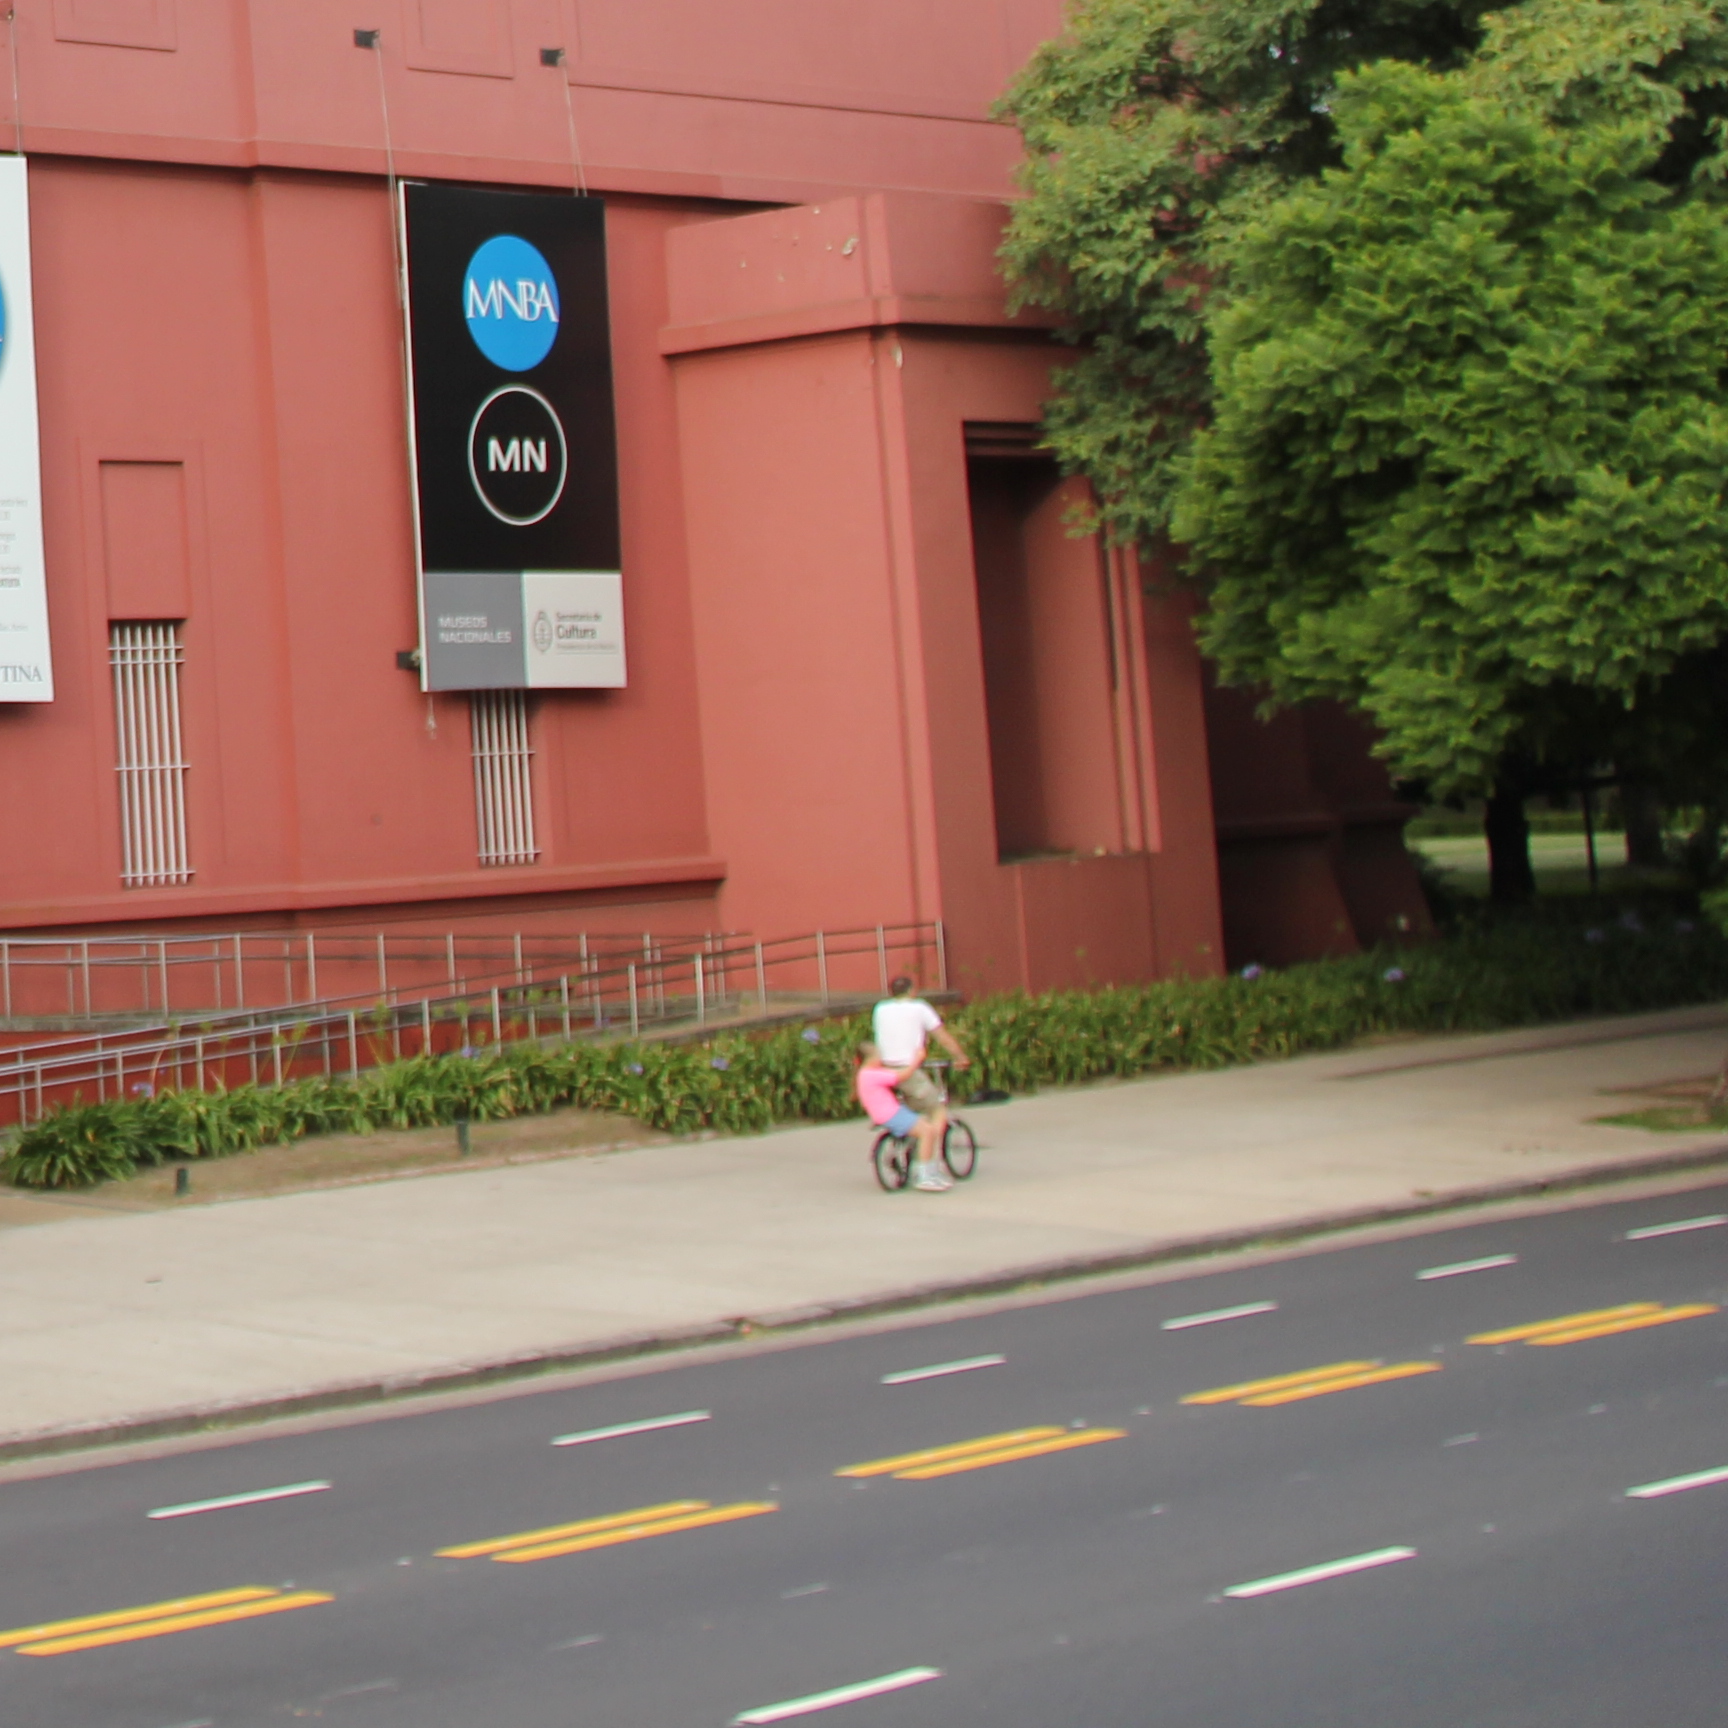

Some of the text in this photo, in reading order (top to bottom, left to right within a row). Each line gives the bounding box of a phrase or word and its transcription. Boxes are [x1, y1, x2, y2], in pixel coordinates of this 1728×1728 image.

[466, 278, 559, 323] MNBA
[488, 437, 546, 472] MN
[438, 616, 488, 629] MUSEOS
[439, 630, 512, 644] NACIONALES
